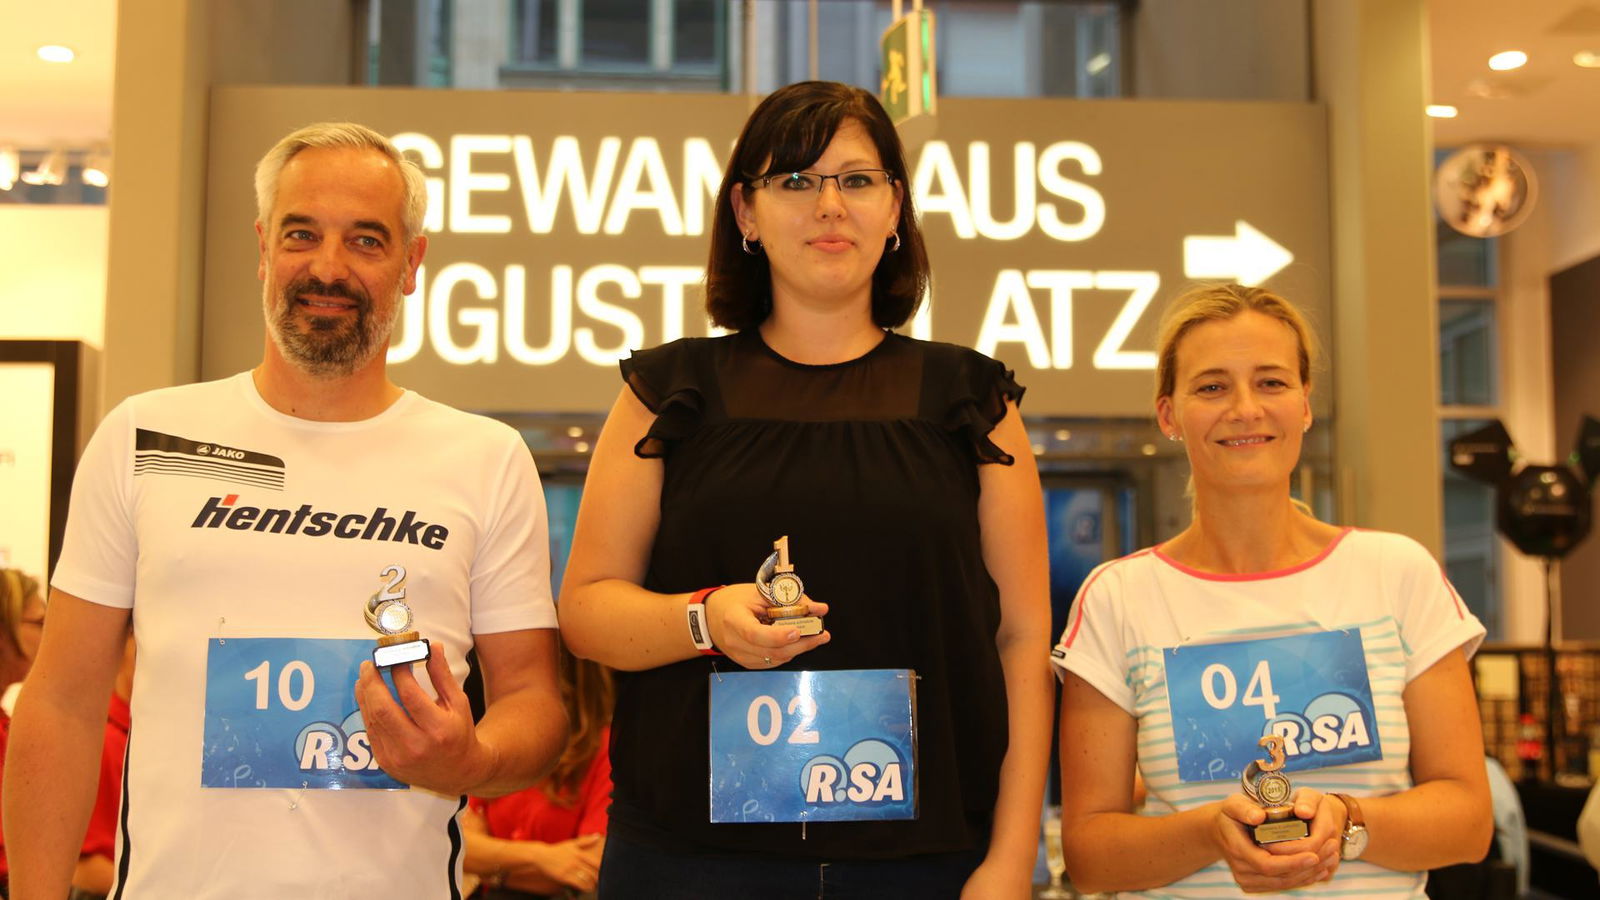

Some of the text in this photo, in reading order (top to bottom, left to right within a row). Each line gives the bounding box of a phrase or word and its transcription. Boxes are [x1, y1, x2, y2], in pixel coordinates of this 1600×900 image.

[211, 447, 246, 460] JAKO
[773, 535, 794, 573] 1
[379, 564, 406, 602] 2
[244, 660, 315, 711] 10
[1201, 660, 1280, 719] 04
[747, 695, 820, 746] 02
[300, 731, 379, 771] R.S
[1256, 734, 1286, 772] 3
[806, 762, 904, 803] R.SA
